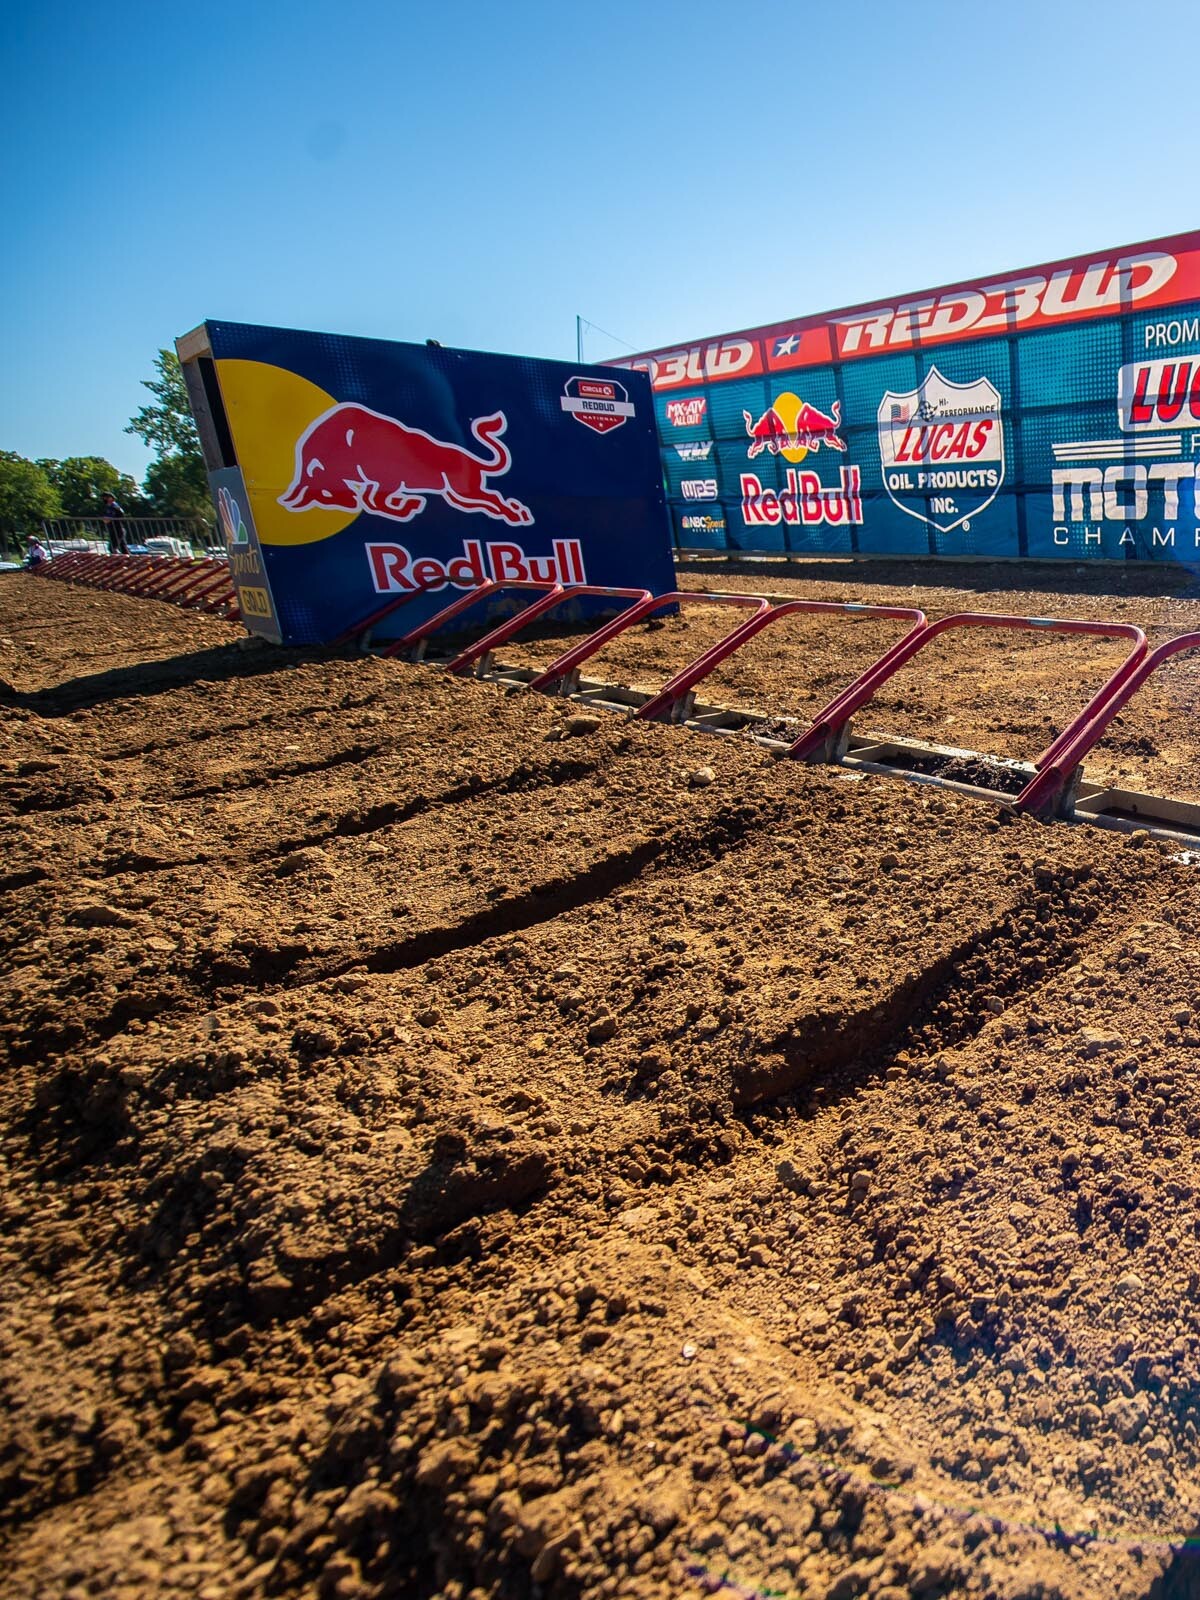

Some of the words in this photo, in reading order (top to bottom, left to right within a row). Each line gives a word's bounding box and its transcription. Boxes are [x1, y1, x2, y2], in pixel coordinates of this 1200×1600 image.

[827, 251, 1177, 353] REDBUD
[582, 401, 615, 412] REDBUD
[939, 404, 996, 418] PERFORMANCE
[673, 415, 686, 427] ALL
[686, 413, 700, 425] OUT
[894, 419, 993, 462] LUCAS
[888, 473, 914, 491] OIL
[917, 469, 998, 489] PRODUCTS
[741, 469, 799, 525] Red
[798, 465, 862, 526] Bull
[930, 497, 959, 514] INC.
[365, 540, 486, 593] Red
[486, 539, 587, 588] Bull
